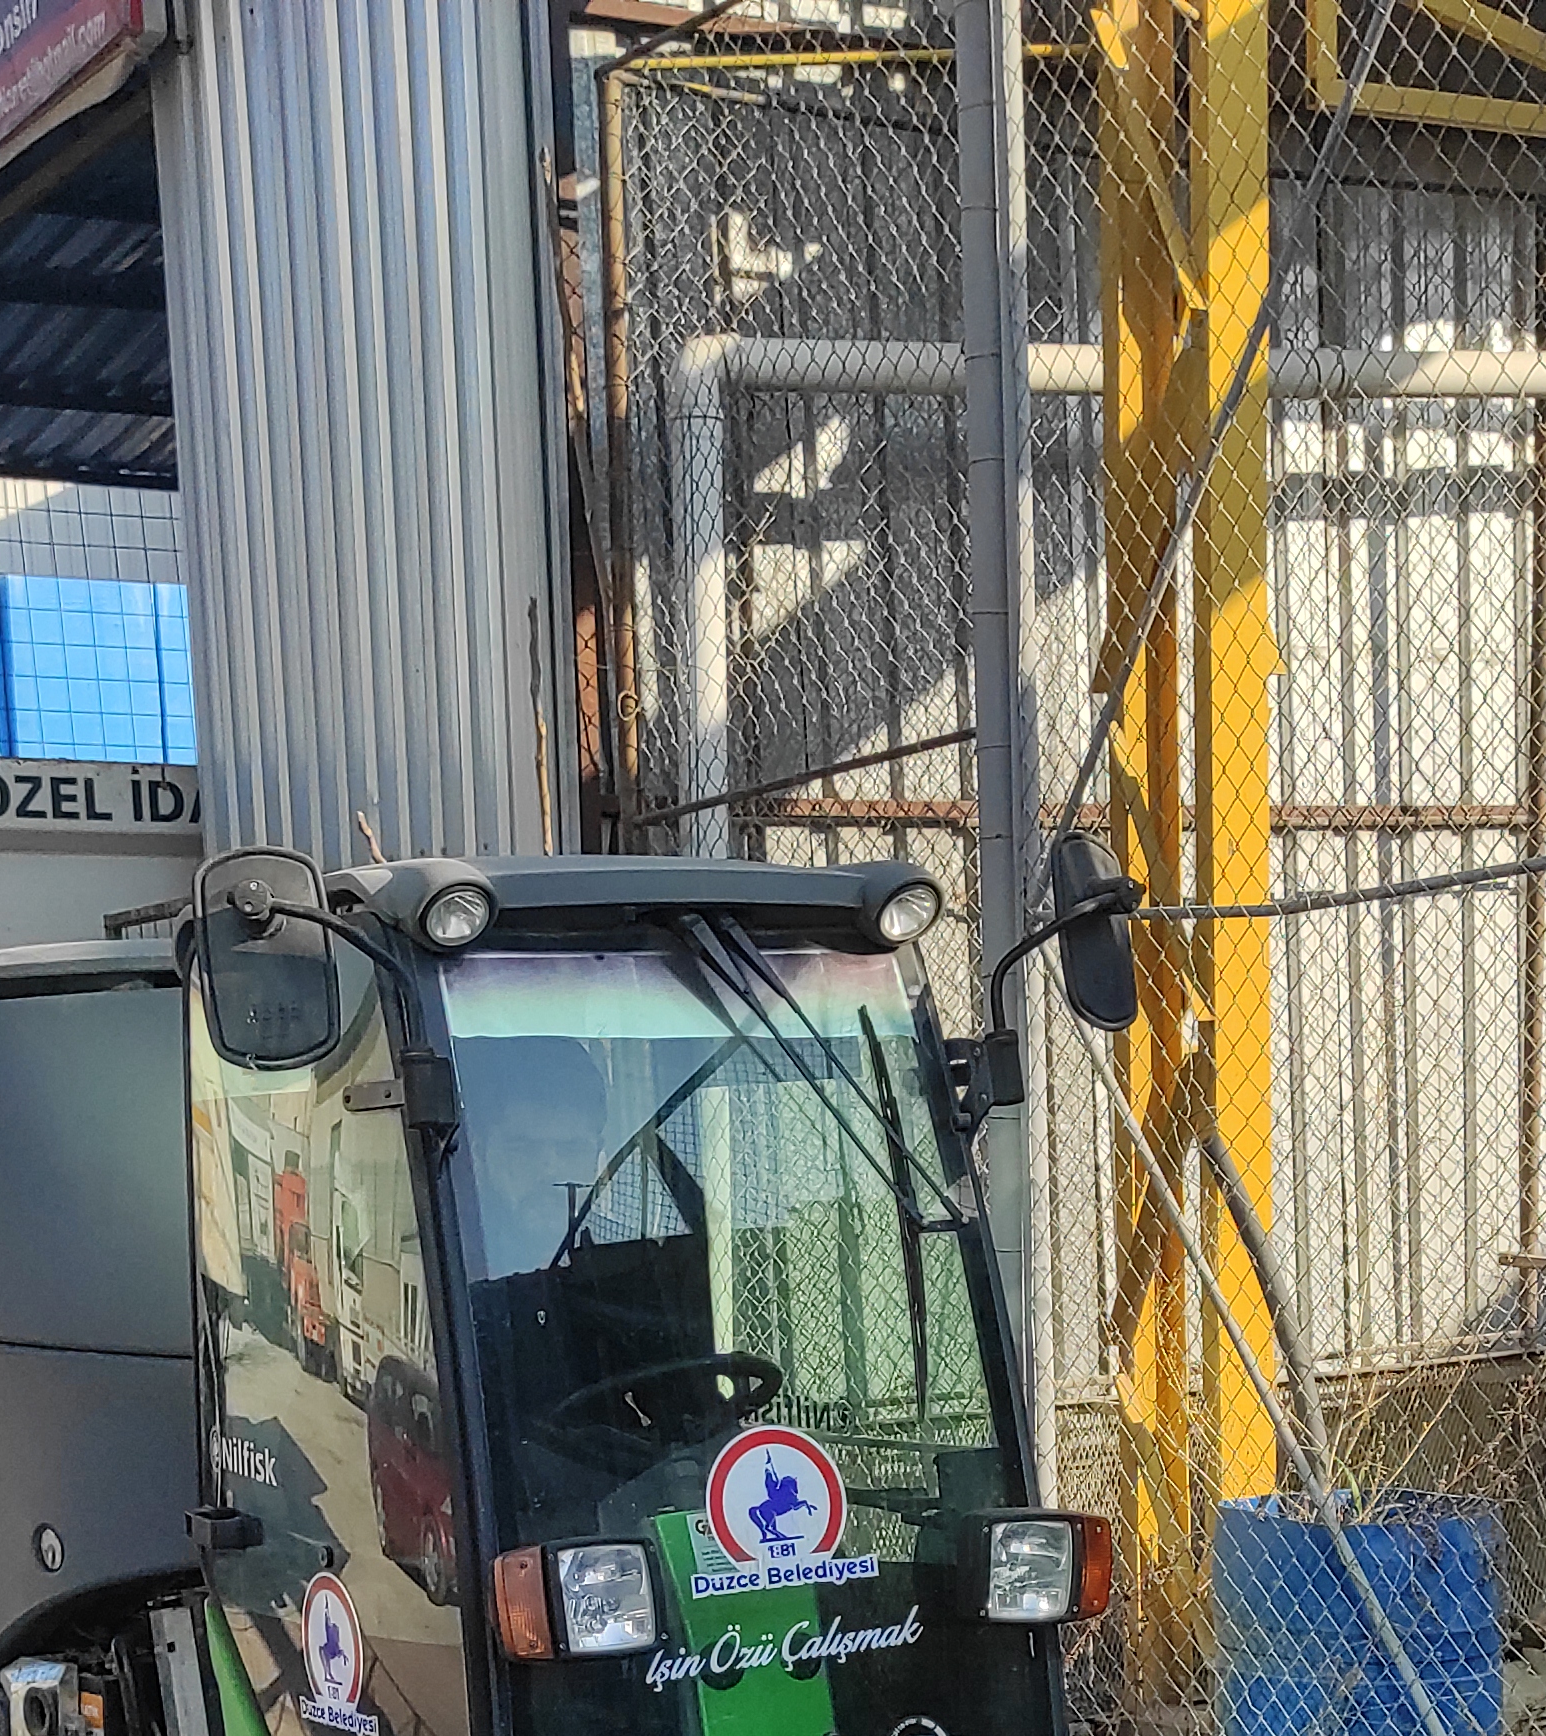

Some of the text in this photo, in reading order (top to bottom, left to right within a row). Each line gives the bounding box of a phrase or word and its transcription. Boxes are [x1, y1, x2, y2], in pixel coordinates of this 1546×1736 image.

[130, 765, 201, 824] İD
[221, 1436, 278, 1487] Nilfisk
[767, 1557, 875, 1586] Belediyesi
[709, 1624, 777, 1674] Özü
[781, 1605, 925, 1672] Çalışmak
[327, 1705, 378, 1734] Belediyesi
